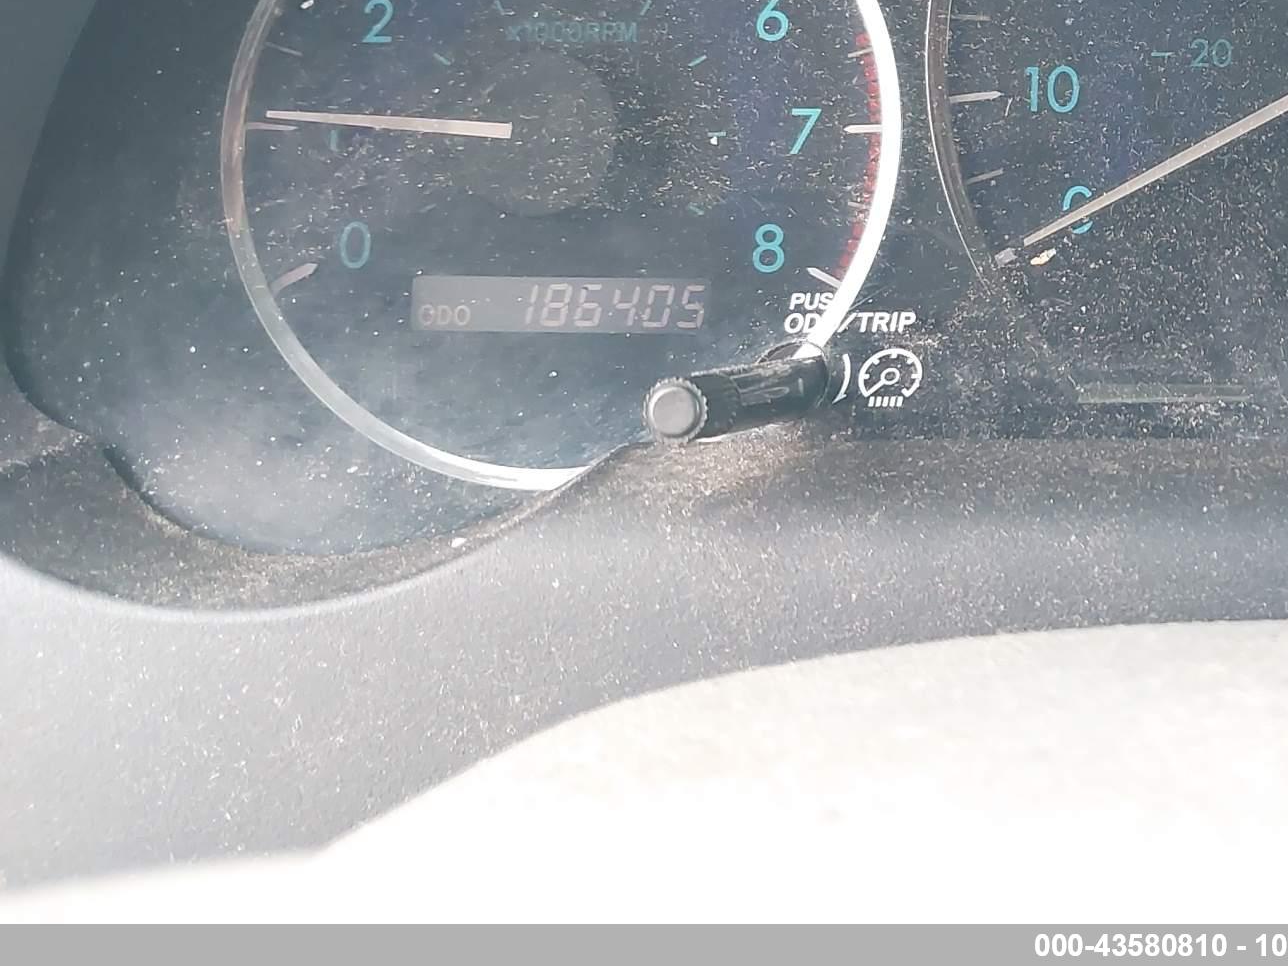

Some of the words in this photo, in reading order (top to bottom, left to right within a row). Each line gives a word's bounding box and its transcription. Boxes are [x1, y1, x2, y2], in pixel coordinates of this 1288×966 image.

[1190, 38, 1233, 68] 20
[1024, 65, 1081, 113] 10
[791, 107, 821, 155] 7
[339, 221, 371, 269] 0
[752, 223, 785, 274] 8
[418, 304, 471, 327] ODO
[523, 282, 706, 330] 186405
[784, 311, 916, 334] OD/TRIP
[789, 292, 836, 311] PUS
